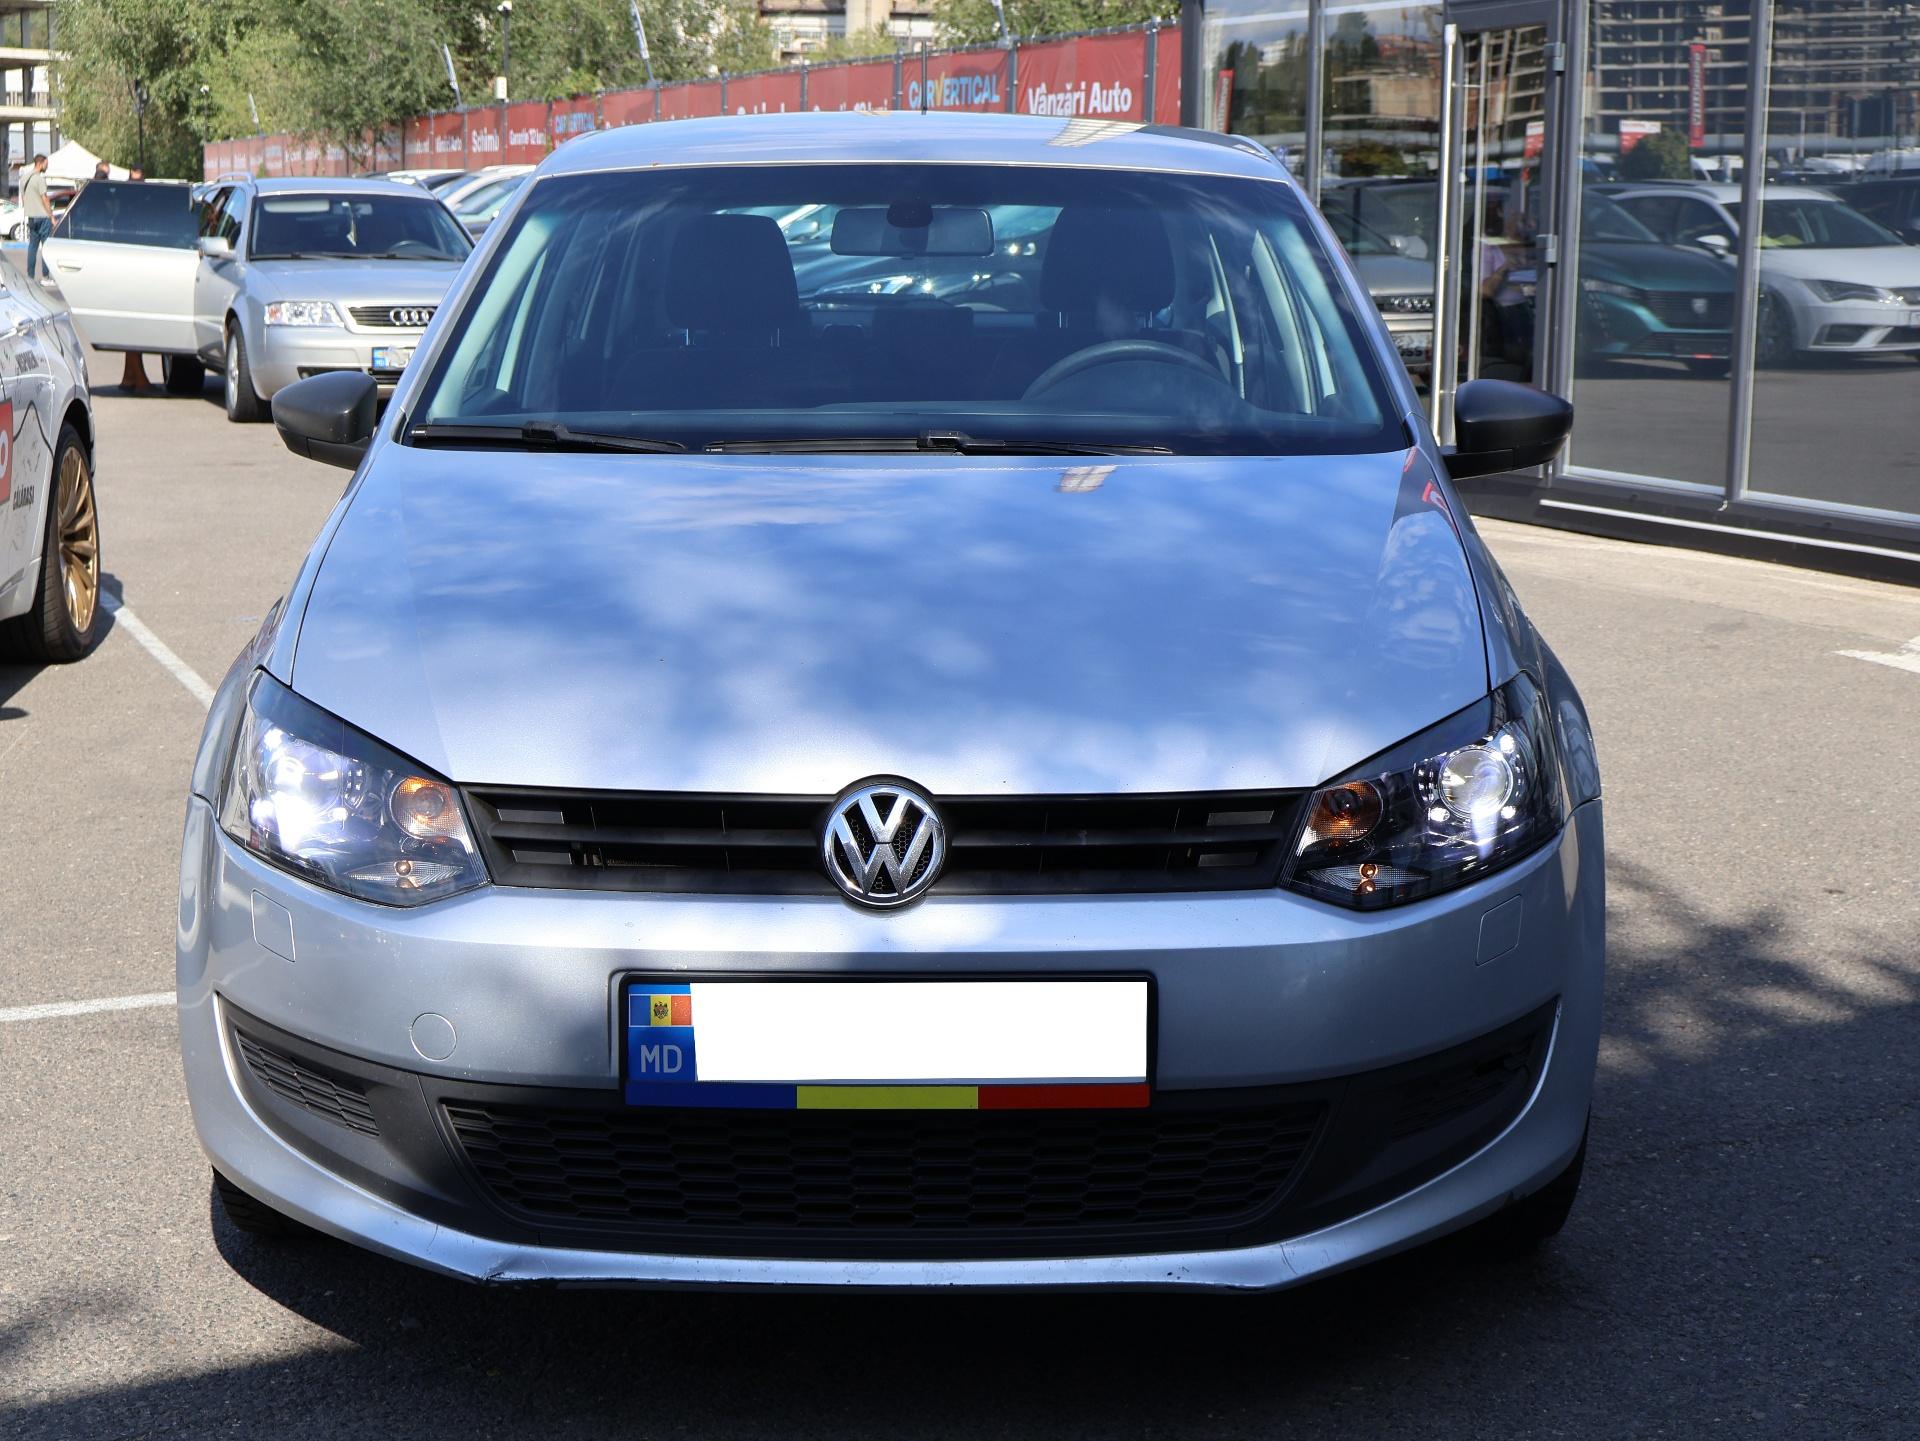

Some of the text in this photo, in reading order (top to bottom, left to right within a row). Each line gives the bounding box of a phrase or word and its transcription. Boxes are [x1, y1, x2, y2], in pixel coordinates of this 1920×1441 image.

[1028, 81, 1132, 115] Vânzări Auto
[472, 127, 499, 153] Schimb
[640, 1045, 683, 1073] MD
